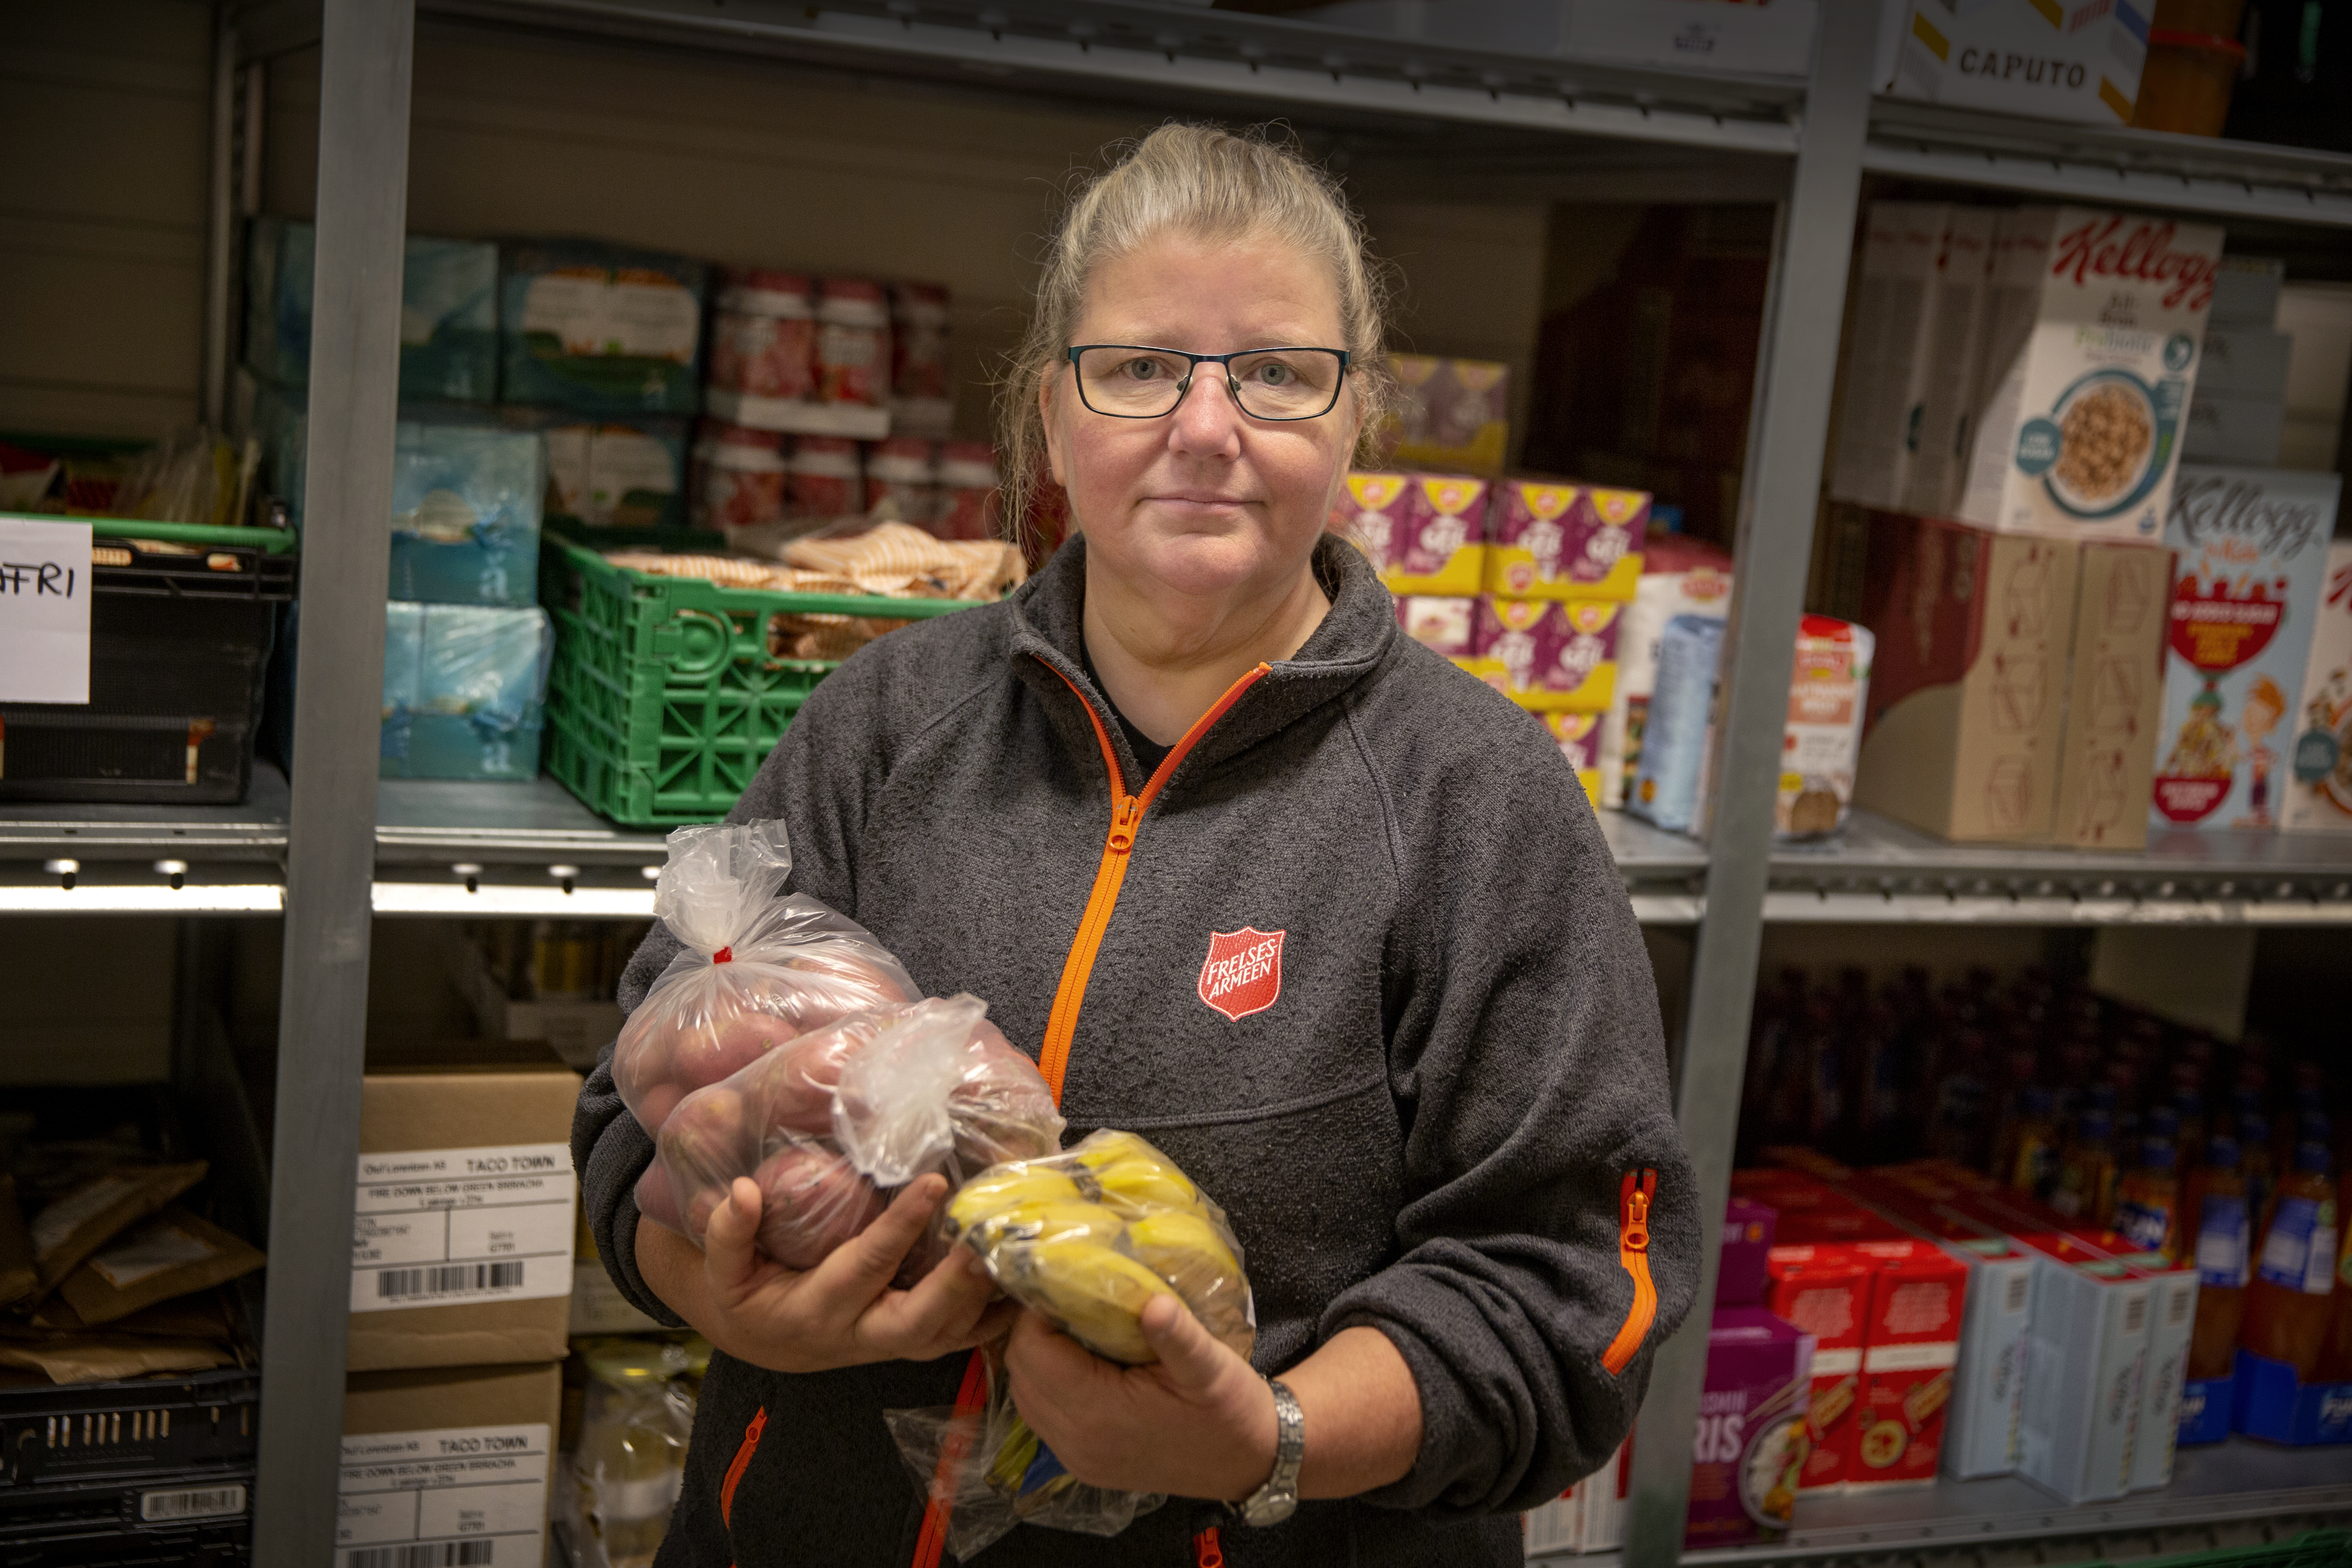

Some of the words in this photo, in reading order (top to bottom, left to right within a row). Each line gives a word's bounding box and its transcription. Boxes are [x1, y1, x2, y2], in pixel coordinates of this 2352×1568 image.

[1960, 47, 2086, 88] CAPUTO
[1207, 939, 1278, 985] FRELSES-
[1209, 958, 1272, 1000] ARMEEN
[466, 1158, 508, 1173] TACO
[512, 1155, 555, 1169] TOWN
[369, 1187, 390, 1199] FIRE
[394, 1185, 423, 1197] DOWN
[426, 1183, 460, 1195] BELOW
[463, 1182, 494, 1192] GREEN
[497, 1178, 544, 1191] SRIRACHA
[439, 1439, 480, 1454] TACO
[484, 1436, 528, 1450] TOWN
[342, 1468, 364, 1479] FIRE
[367, 1466, 395, 1478] DOWN
[398, 1464, 432, 1475] BELOW
[434, 1463, 467, 1473] GREEN
